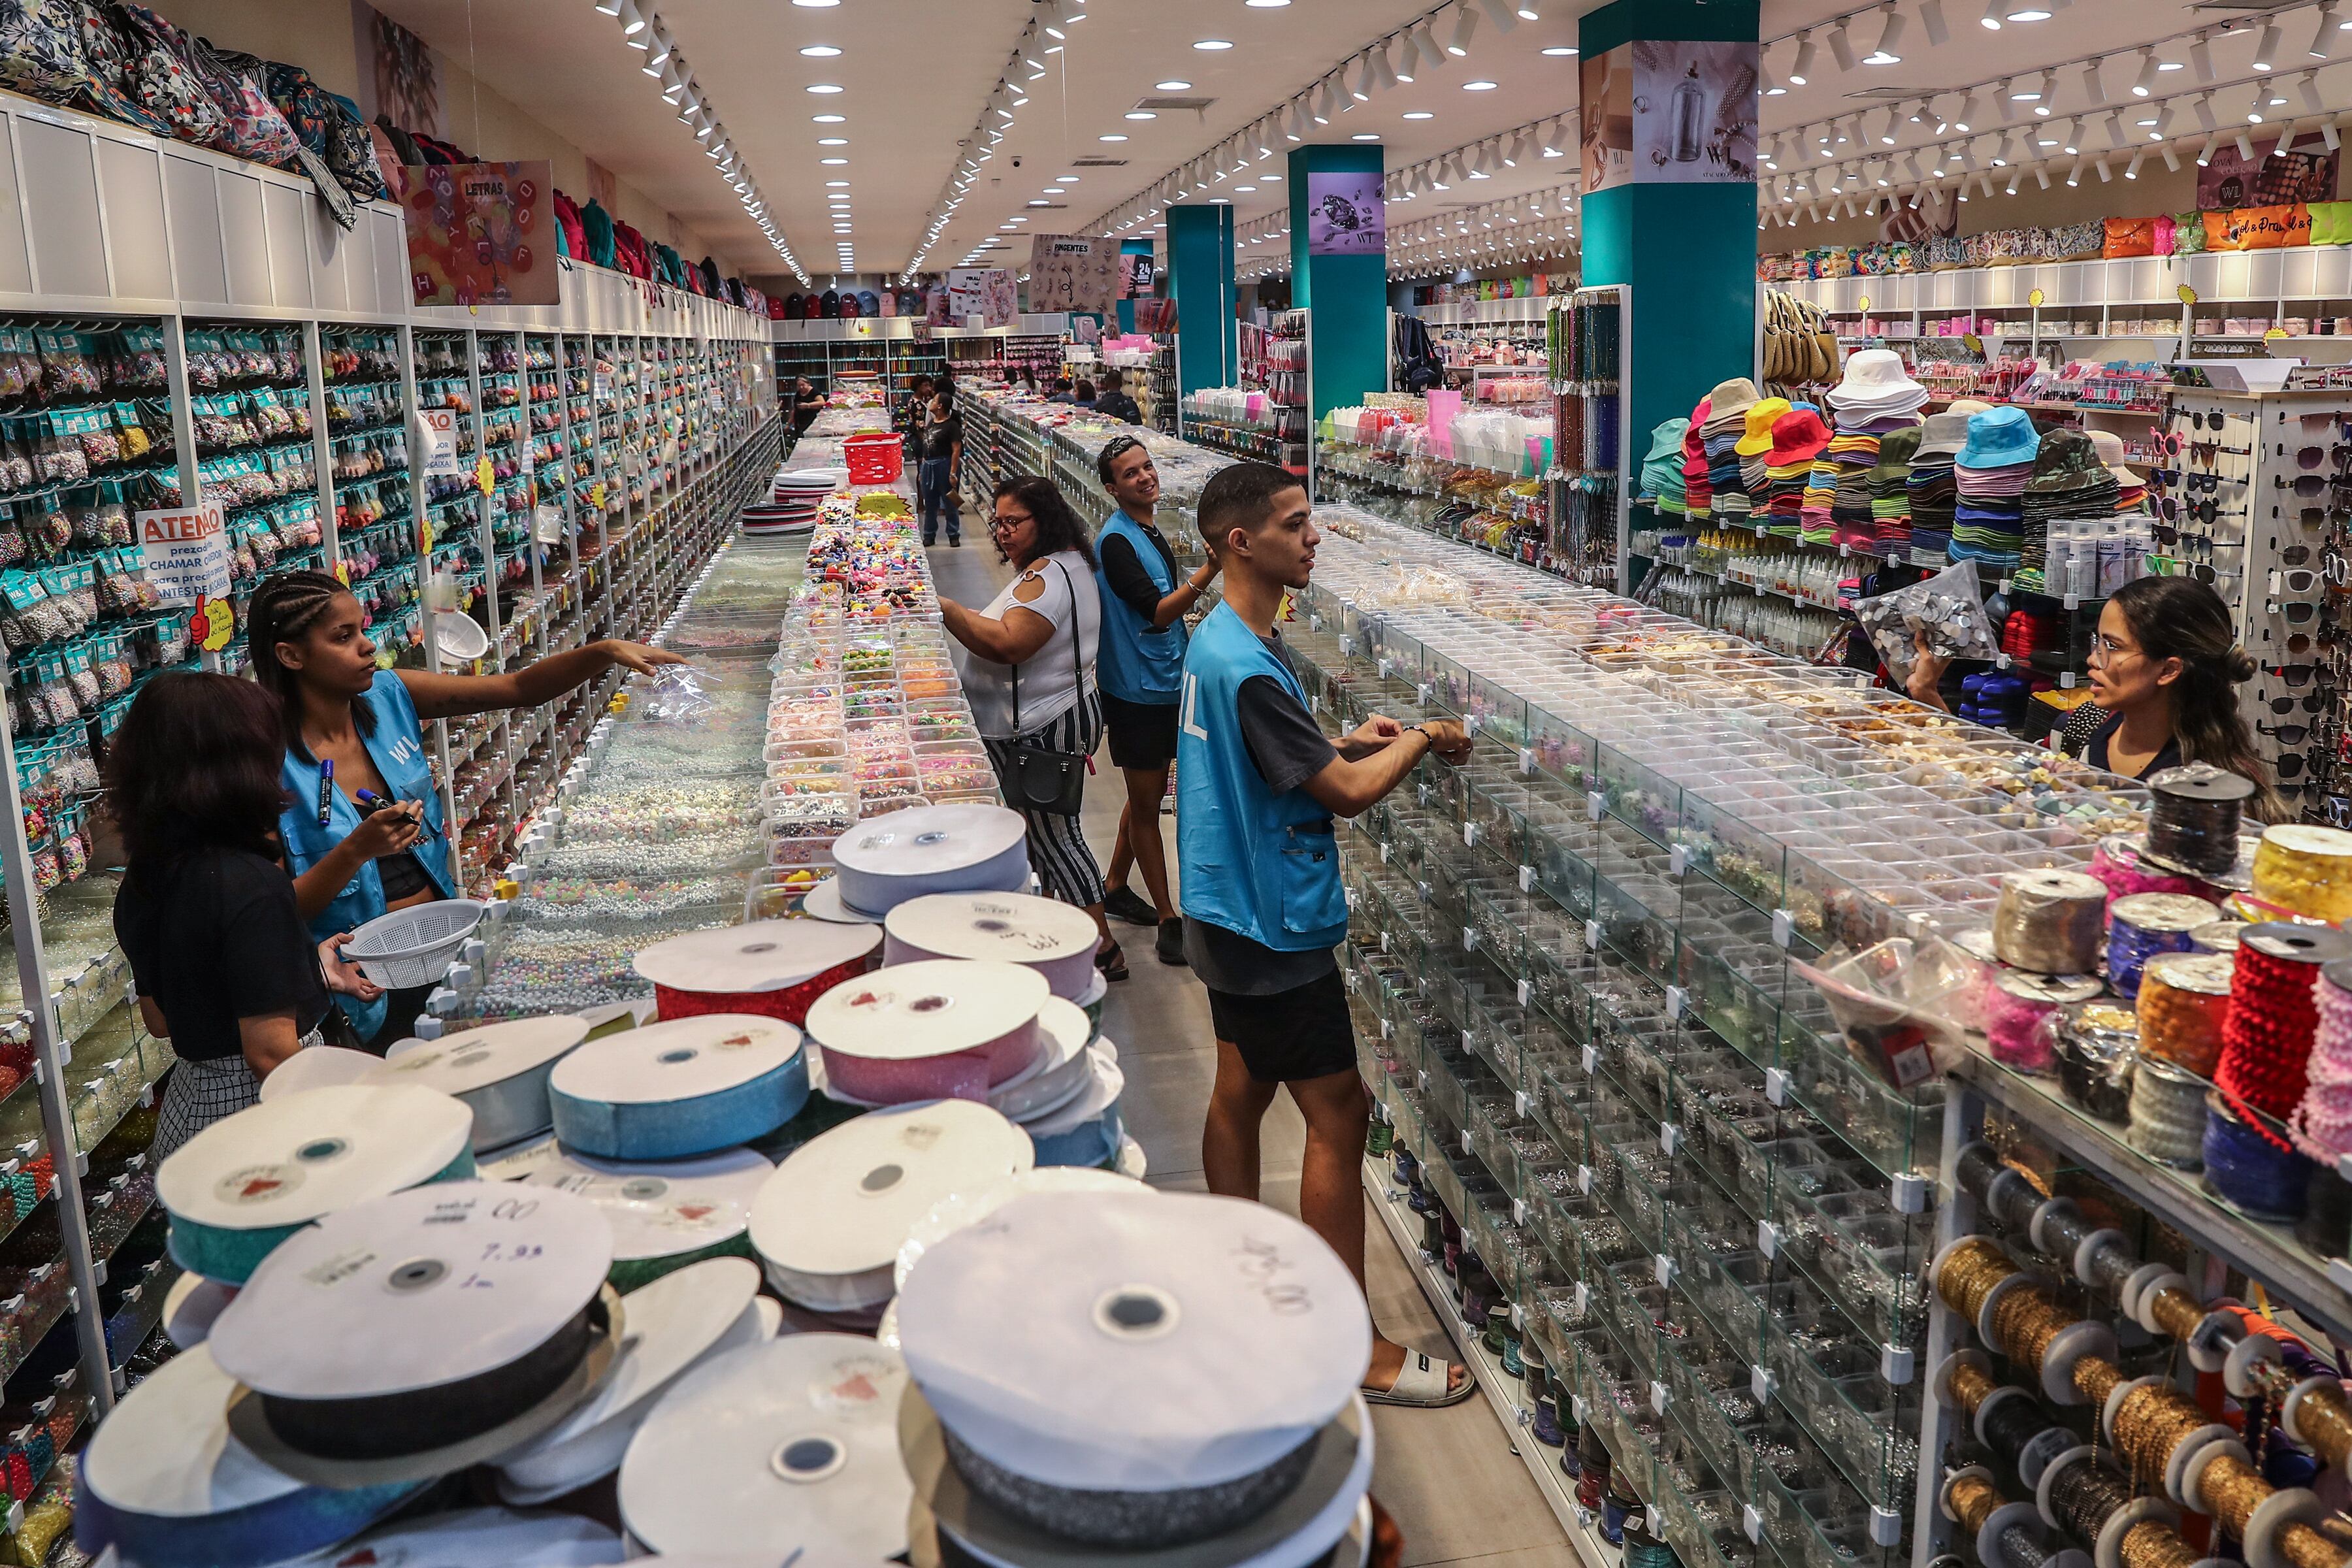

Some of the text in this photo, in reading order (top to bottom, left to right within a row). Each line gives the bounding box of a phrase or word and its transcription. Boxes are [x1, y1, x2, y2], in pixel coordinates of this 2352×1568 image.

[465, 182, 503, 195] LETRAS
[2221, 186, 2242, 199] WL
[1054, 244, 1088, 252] PINGENTES
[1139, 263, 1151, 274] 24
[150, 557, 202, 571] CHAMAR
[8, 589, 25, 600] W&L
[194, 585, 208, 595] DE
[389, 736, 420, 765] WL
